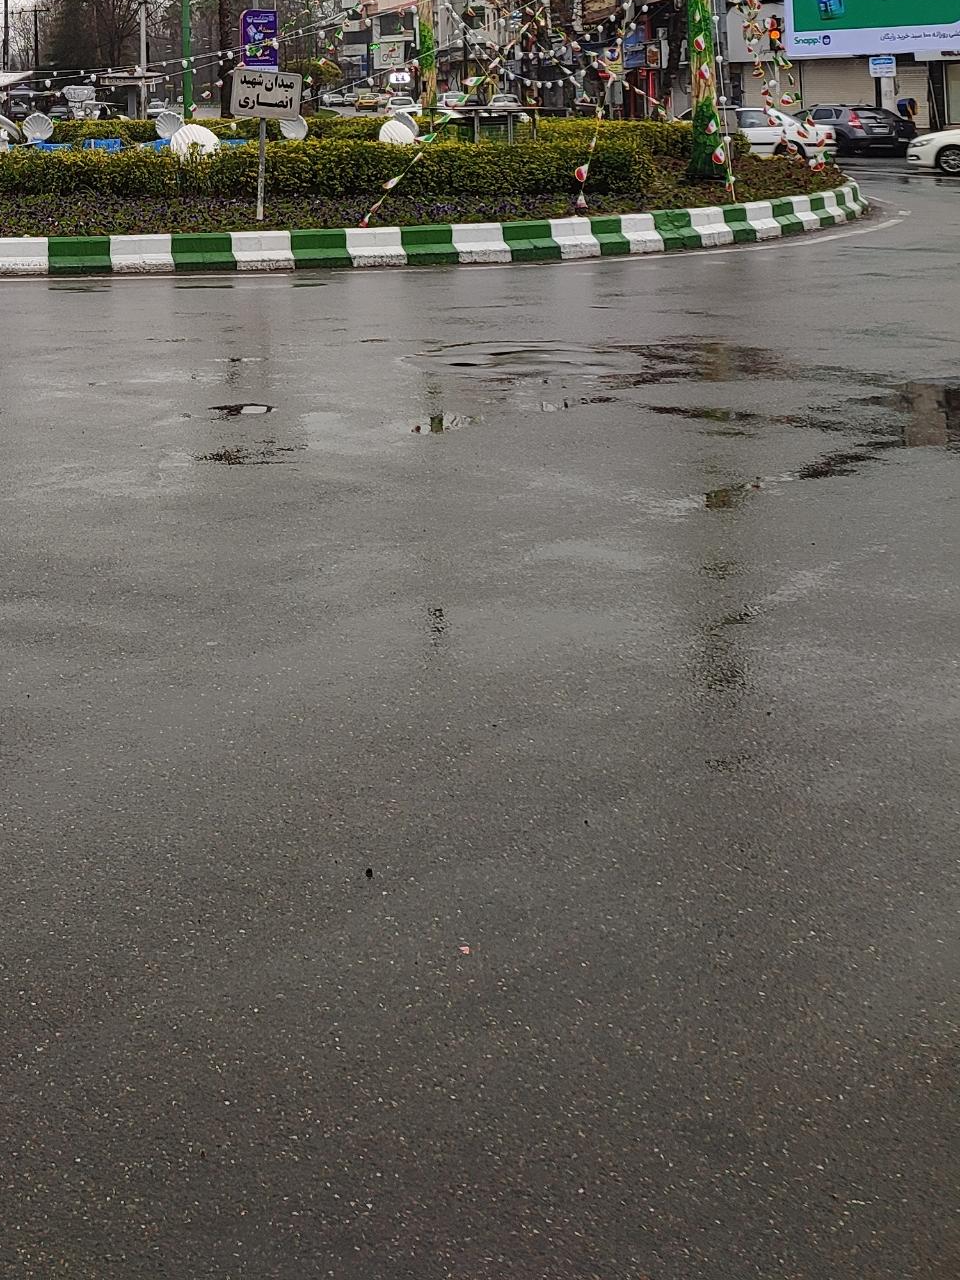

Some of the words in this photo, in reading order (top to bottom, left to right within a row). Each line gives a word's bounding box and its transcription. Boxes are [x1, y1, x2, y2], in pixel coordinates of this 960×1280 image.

[240, 73, 264, 88] شهید
[264, 74, 295, 92] میدان
[238, 93, 293, 110] انصاری
